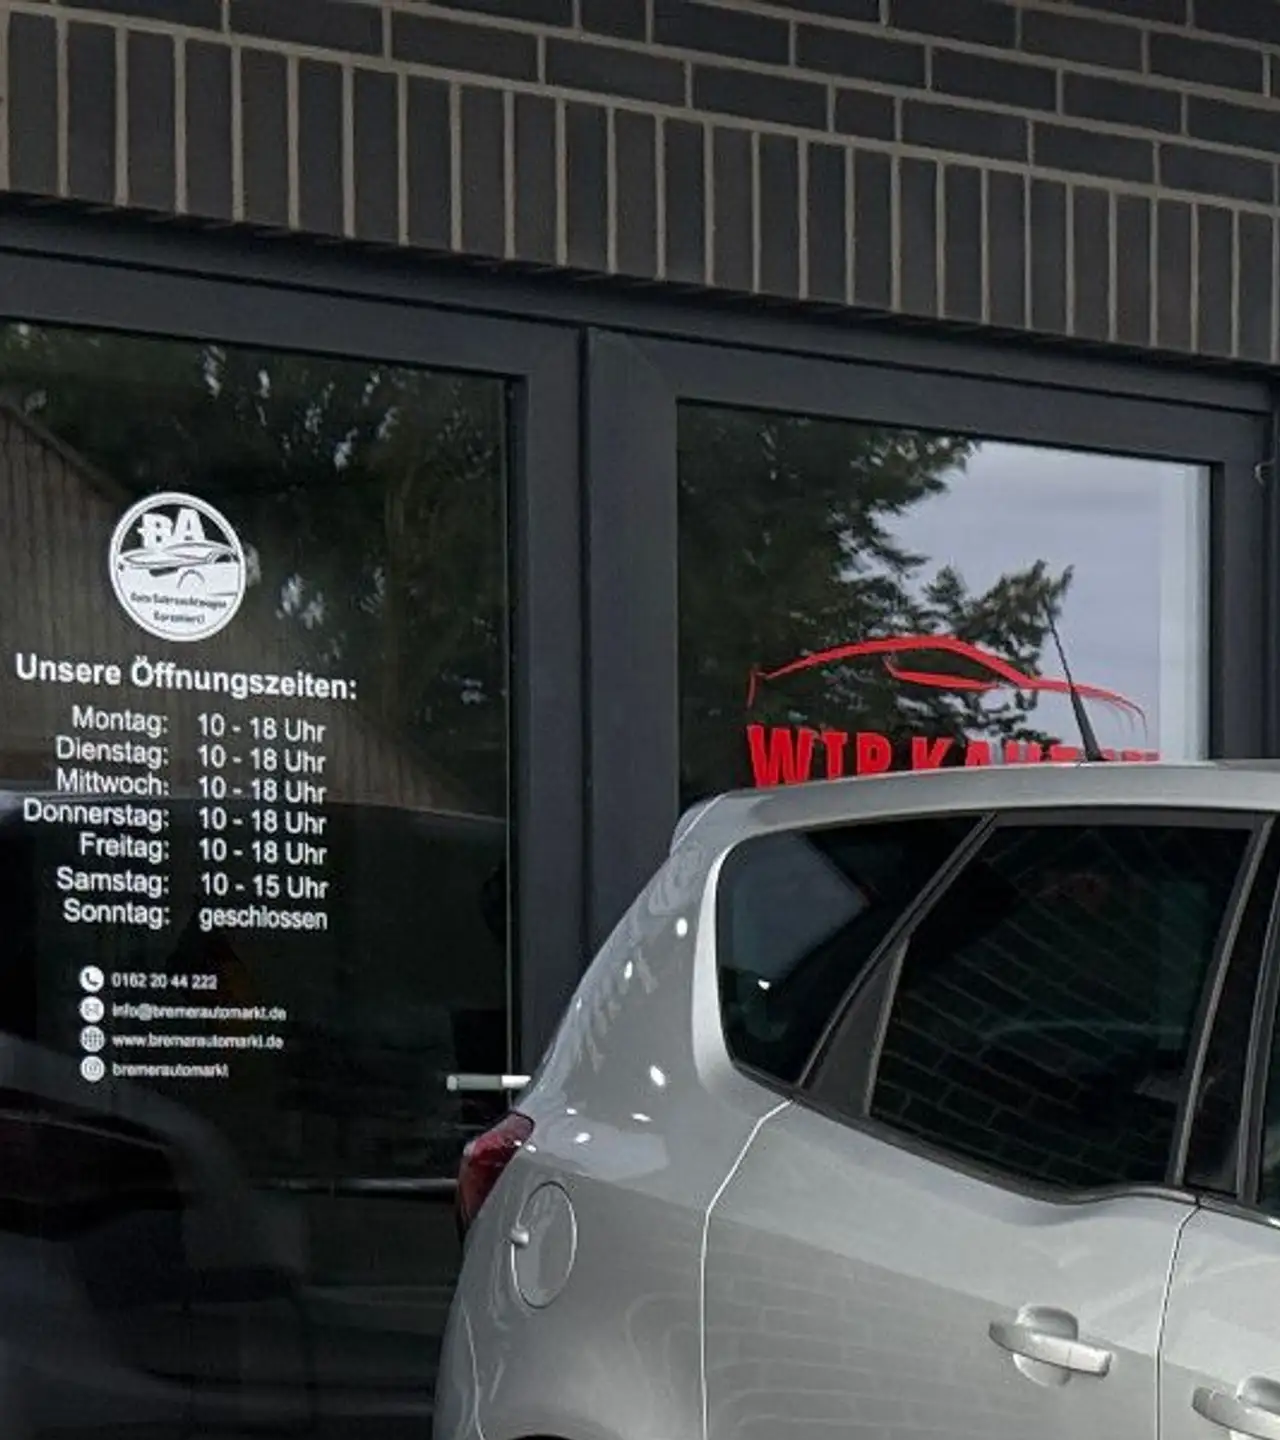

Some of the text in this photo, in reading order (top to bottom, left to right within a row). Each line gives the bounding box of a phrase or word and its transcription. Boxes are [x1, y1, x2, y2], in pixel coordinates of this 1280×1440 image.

[15, 651, 357, 700] Unsere Öffnungszeiten:
[71, 705, 169, 738] Montag:
[198, 713, 226, 736] 10
[250, 718, 277, 739] 18
[284, 717, 326, 743] Uhr
[55, 735, 169, 768] Dienstag:
[198, 744, 227, 768] 10
[250, 748, 278, 771] 18
[284, 748, 326, 774] Uhr
[56, 767, 169, 797] Mittwoch:
[199, 776, 227, 799] 10
[251, 780, 278, 802] 18
[284, 779, 327, 805] Uhr
[23, 797, 169, 834] Donnerstag:
[199, 806, 228, 831] 10
[251, 810, 279, 833] 18
[284, 809, 327, 836] Uhr
[79, 832, 169, 865] Freitag:
[199, 838, 228, 862] 10
[251, 840, 279, 864] 18
[284, 841, 327, 866] Uhr
[56, 866, 169, 899] Samstag:
[200, 872, 229, 896] 10
[252, 874, 280, 898] 15
[286, 873, 329, 900] Uhr
[63, 898, 328, 932] Sonntag: geschlossen
[149, 972, 167, 990] 20
[170, 973, 189, 990] 44
[191, 973, 218, 991] 222
